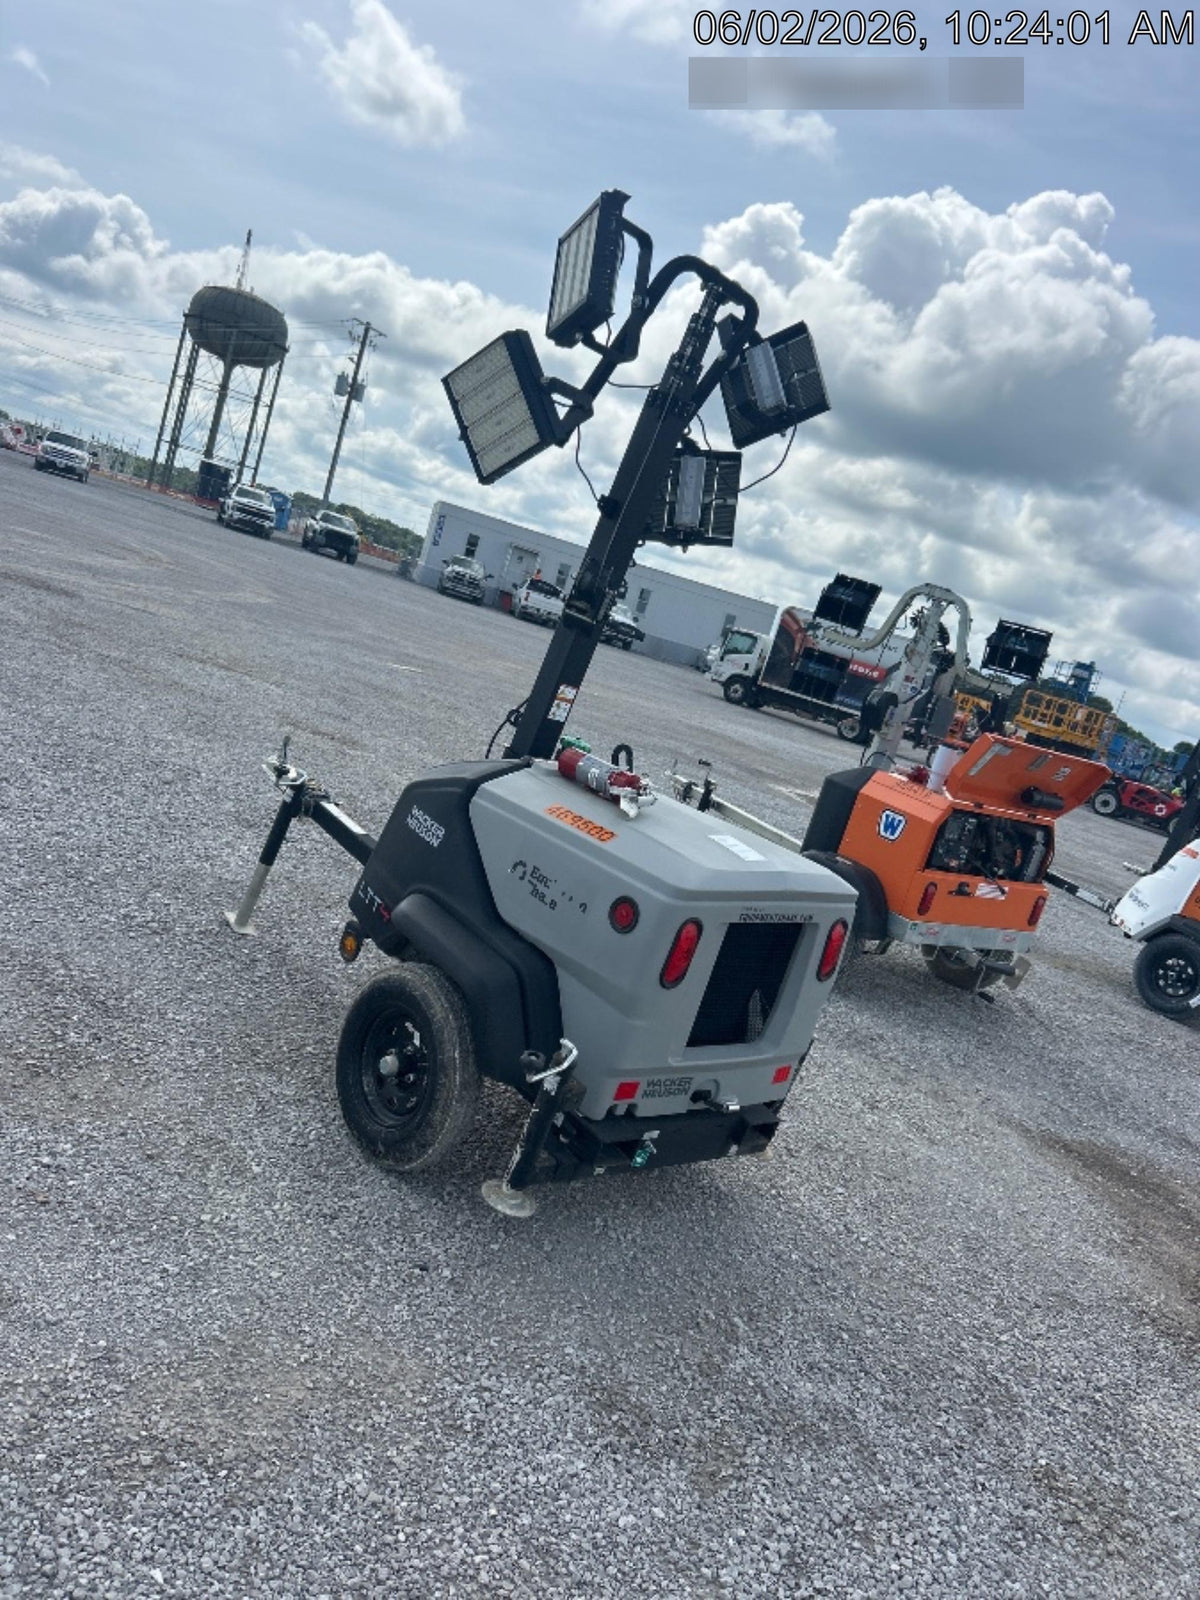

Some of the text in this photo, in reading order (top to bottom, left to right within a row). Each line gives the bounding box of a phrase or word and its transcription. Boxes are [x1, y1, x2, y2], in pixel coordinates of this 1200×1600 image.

[406, 813, 443, 847] NEUSON
[411, 804, 445, 837] WACKER
[646, 1077, 694, 1089] WACKER
